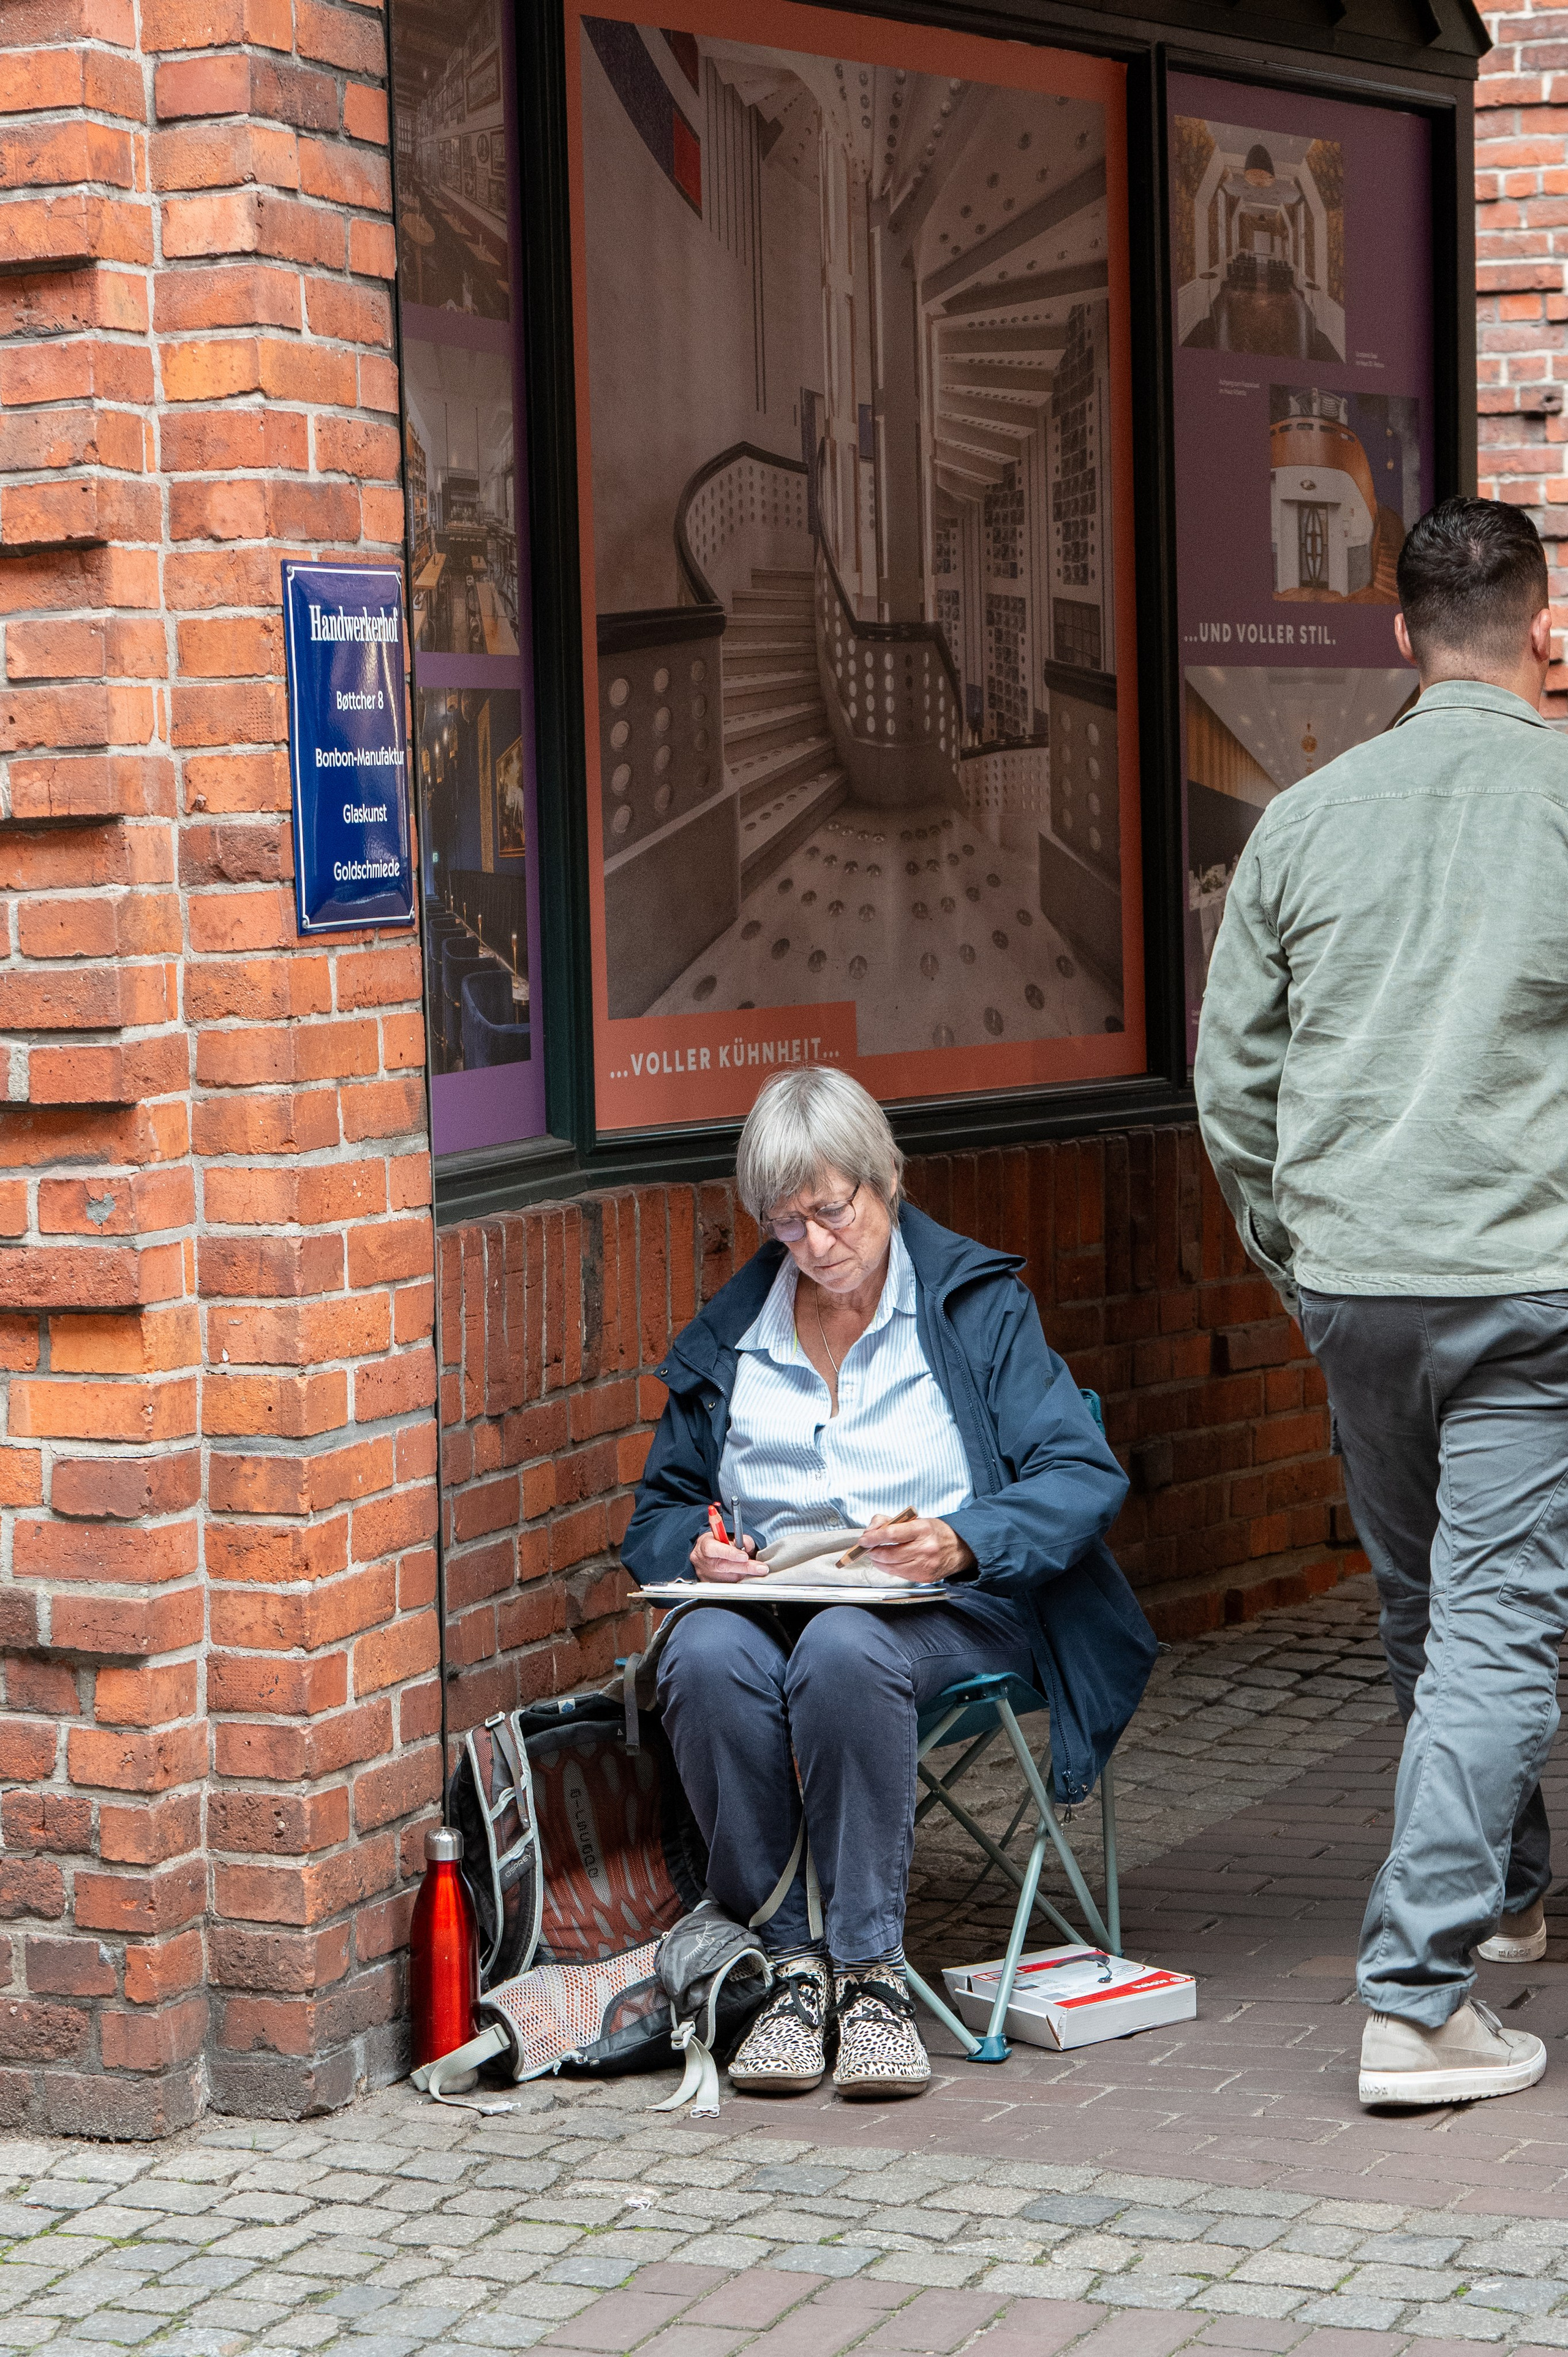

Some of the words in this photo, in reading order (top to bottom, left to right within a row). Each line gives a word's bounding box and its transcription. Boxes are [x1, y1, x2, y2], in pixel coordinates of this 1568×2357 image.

[309, 605, 398, 643] Handwerkerhof
[1237, 624, 1294, 644] VOLLER
[1299, 626, 1336, 645] STIL.
[377, 690, 384, 709] 8
[315, 746, 404, 768] Bonbon-Manufaktur
[343, 804, 387, 824] Glaskunst
[333, 860, 400, 882] Goldschmiede
[505, 1853, 532, 1877] OSPREY
